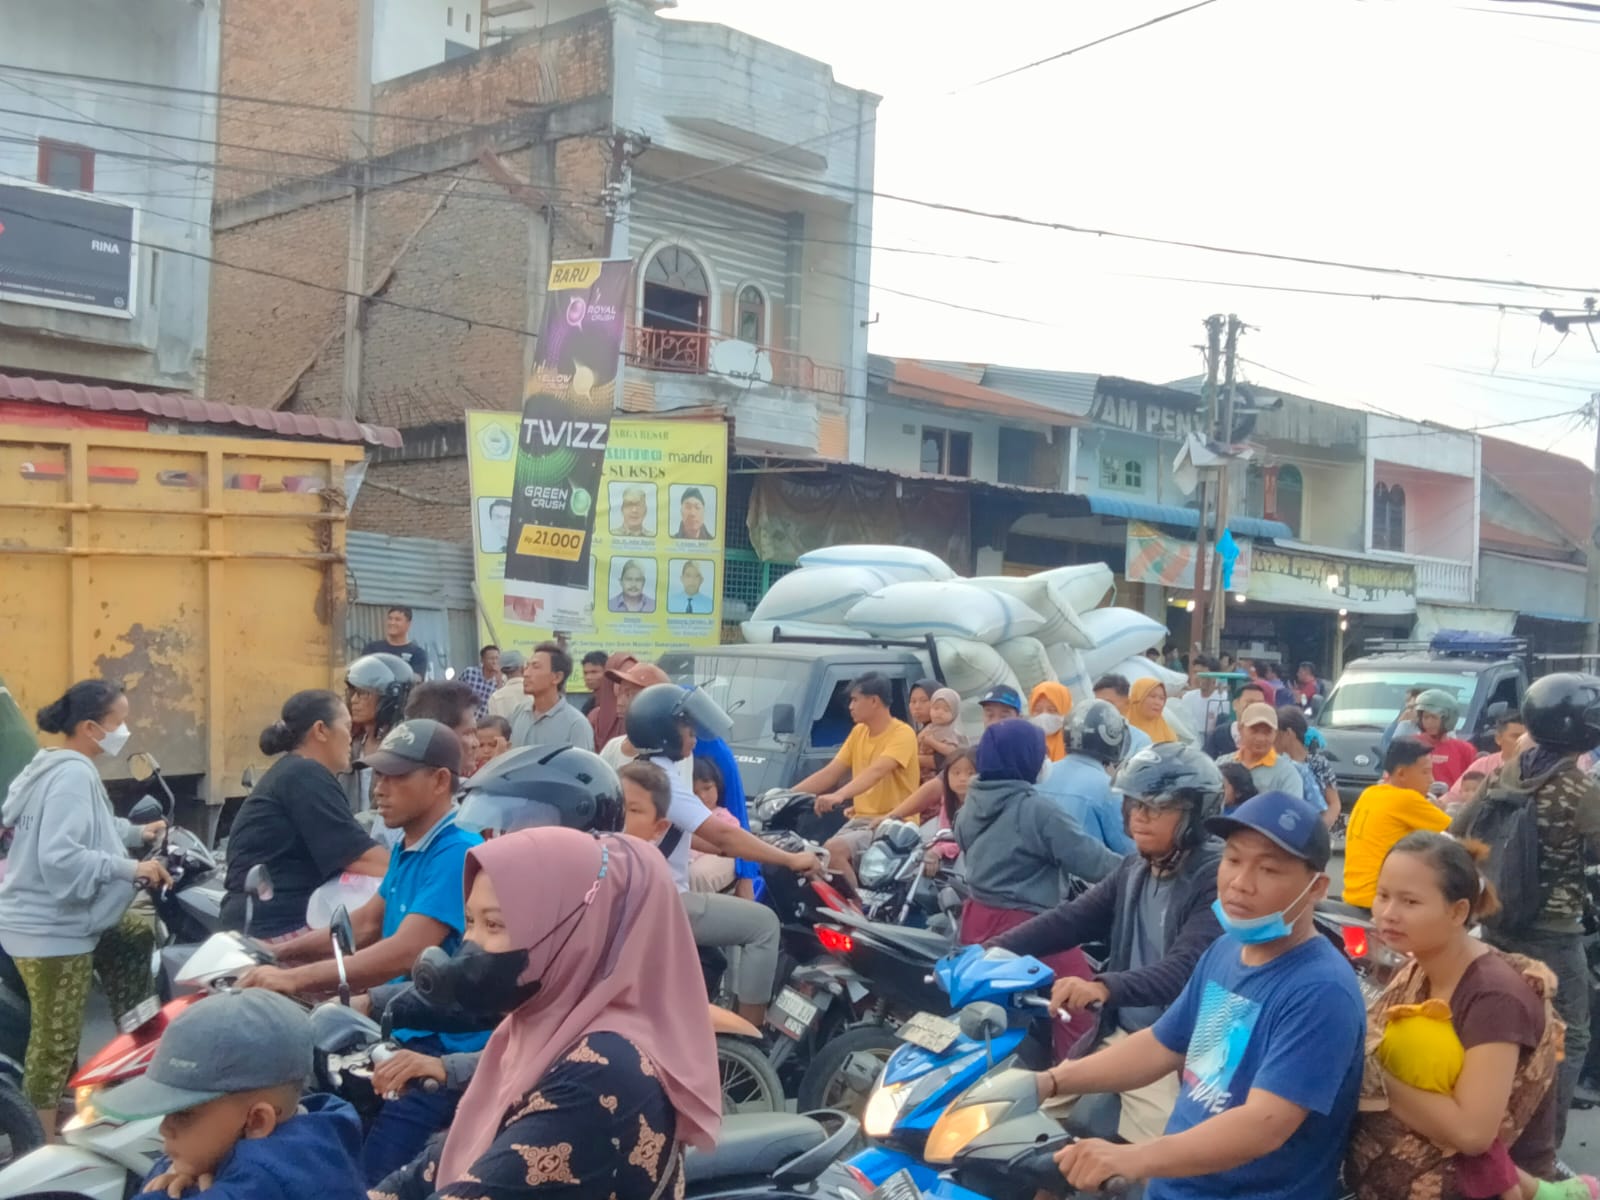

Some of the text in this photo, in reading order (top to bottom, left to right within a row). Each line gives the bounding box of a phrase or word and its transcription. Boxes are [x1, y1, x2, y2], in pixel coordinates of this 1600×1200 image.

[91, 240, 120, 254] RINA
[552, 266, 590, 284] BARU
[587, 305, 616, 315] ROYAL
[523, 418, 608, 449] TWIZZ
[610, 465, 666, 478] SUKSES
[524, 486, 568, 500] GREEN
[531, 498, 566, 510] CRUSH
[533, 530, 581, 549] 21.000
